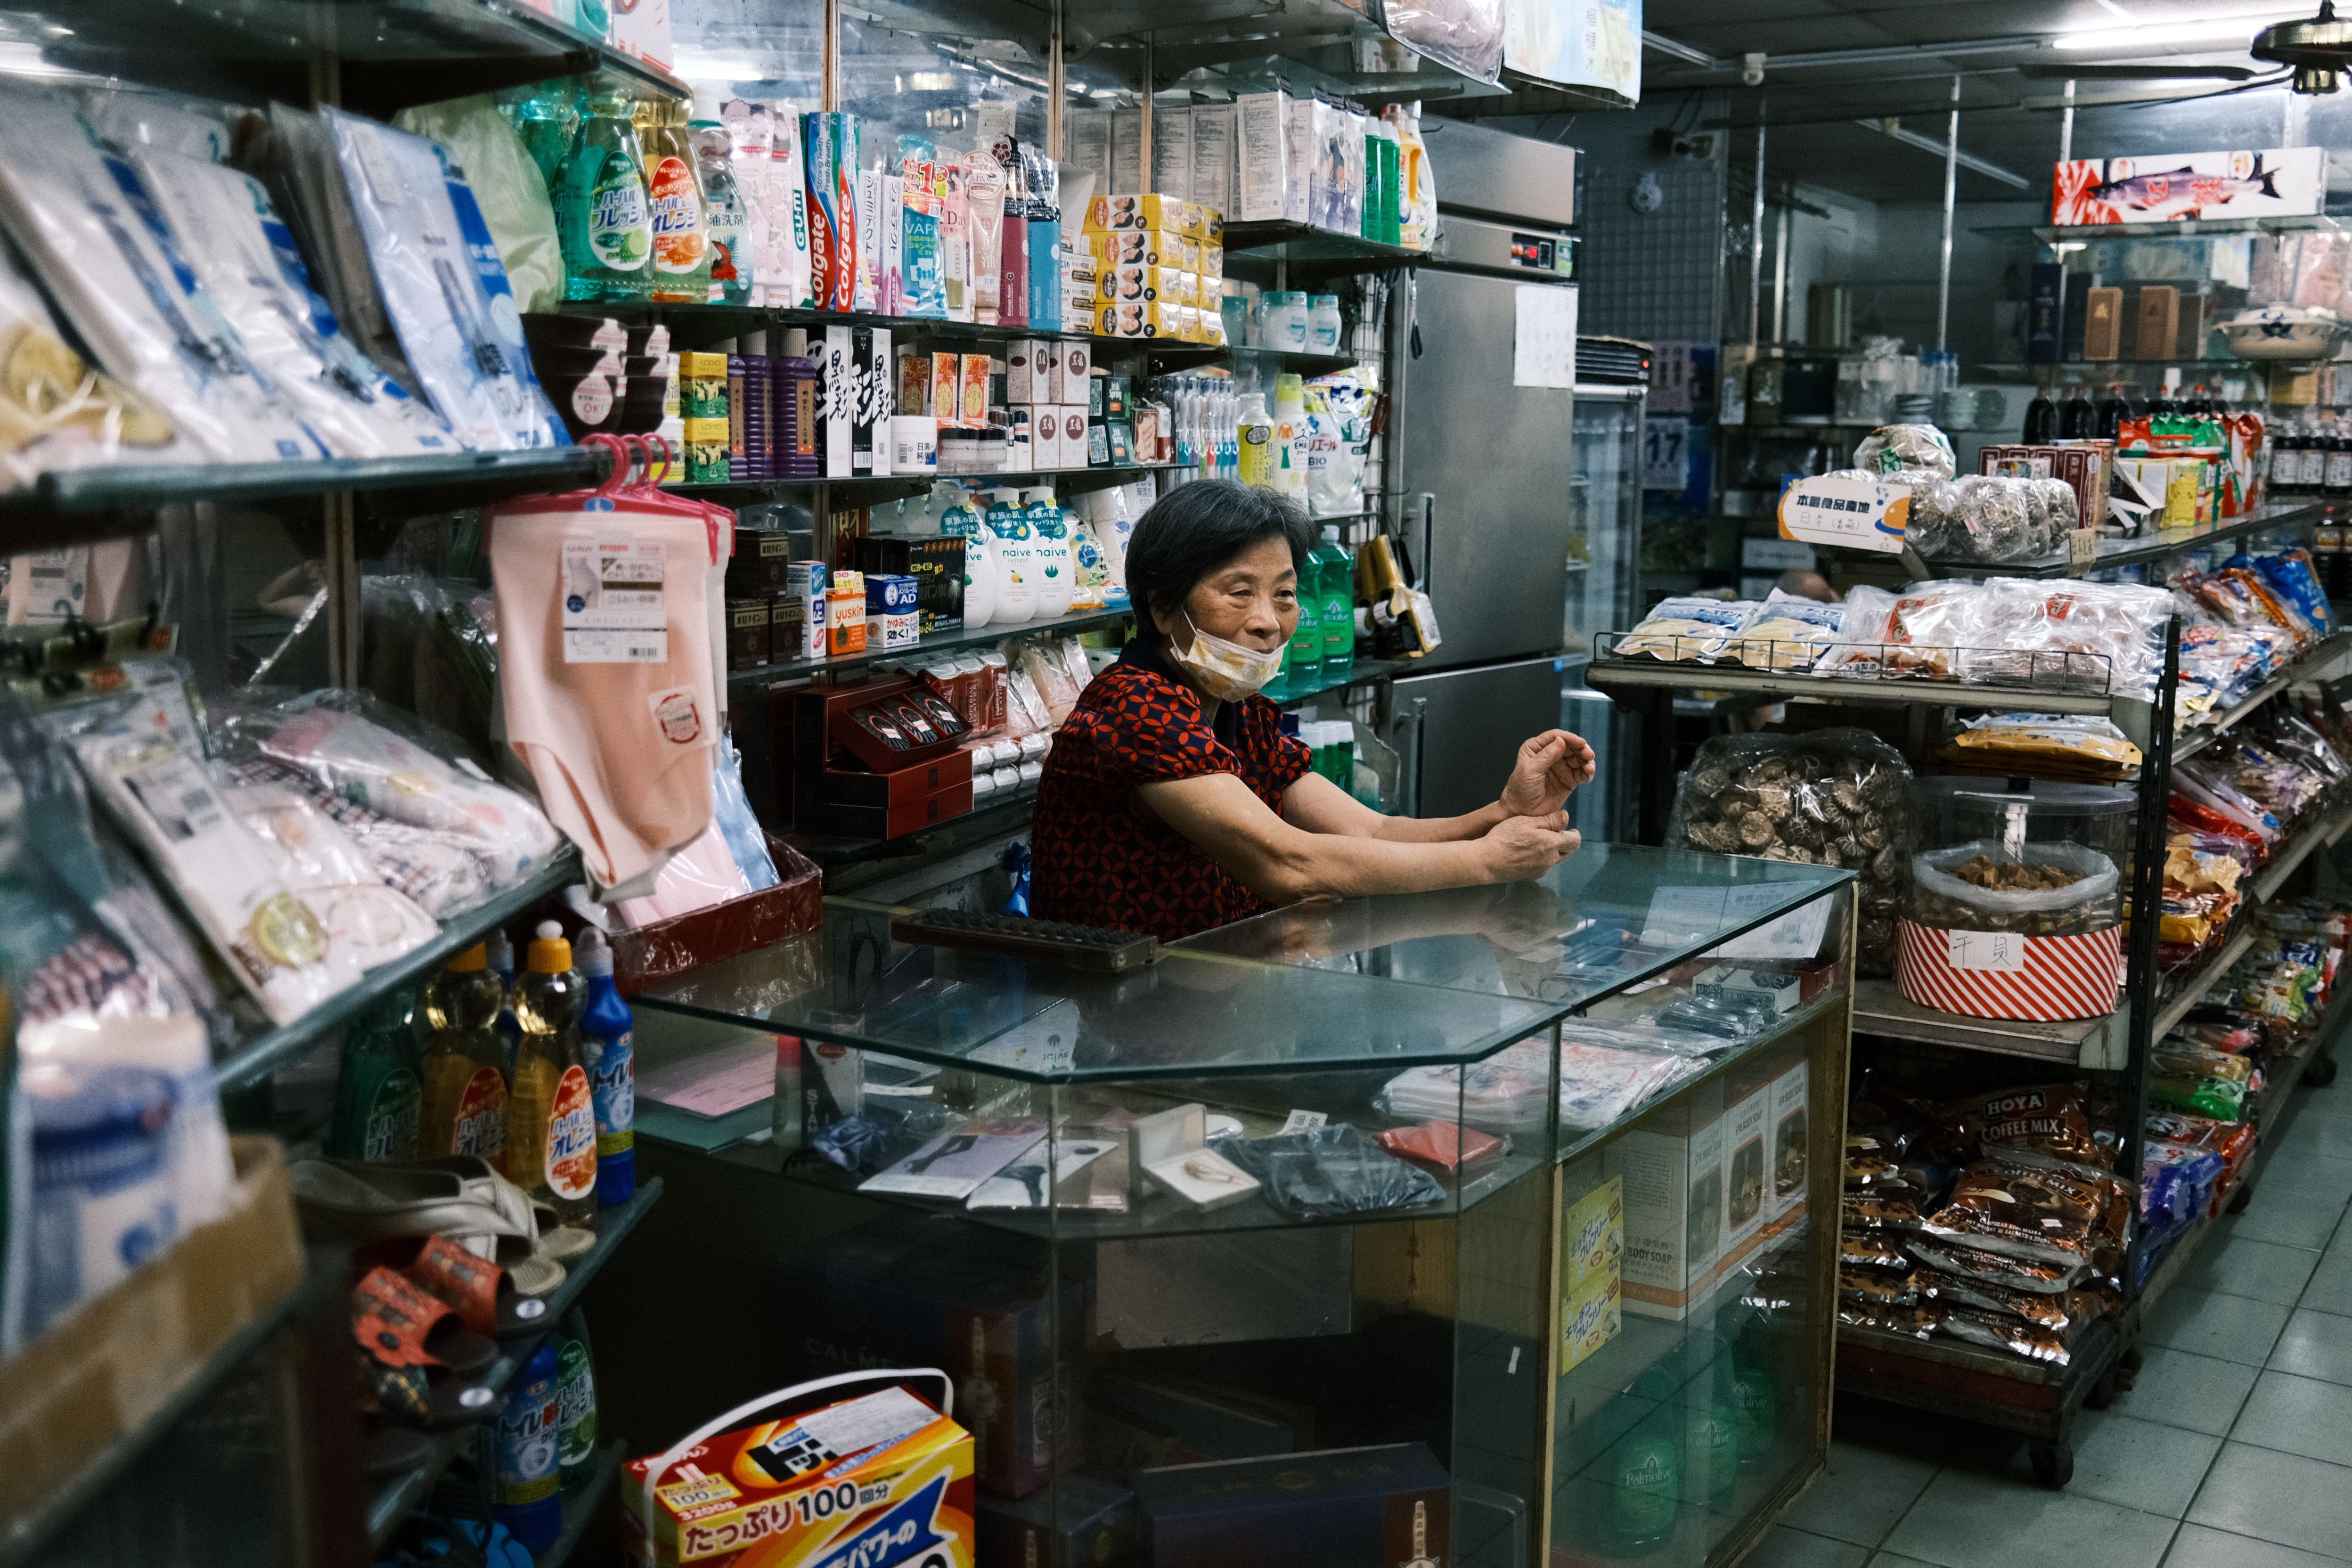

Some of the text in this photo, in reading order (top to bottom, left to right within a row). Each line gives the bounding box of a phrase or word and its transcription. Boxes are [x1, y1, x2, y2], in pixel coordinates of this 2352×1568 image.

[865, 175, 875, 254] シュミテクト
[948, 211, 967, 230] Day
[837, 194, 853, 307] Colgate
[813, 214, 828, 307] Colgate
[1109, 389, 1122, 401] Spring
[1111, 381, 1120, 390] Irish
[1646, 434, 1682, 463] 17
[1309, 457, 1327, 466] BIO
[989, 510, 1024, 520] 家族の肌、
[1027, 509, 1060, 519] 家族の肌、
[1003, 548, 1031, 557] naive
[1036, 546, 1067, 558] naive
[900, 594, 917, 605] AD
[836, 605, 864, 623] yuskin
[886, 617, 909, 628] かゆみに
[1986, 1094, 2044, 1116] HOYA
[1981, 1119, 2060, 1144] COFFEE MIX
[551, 1128, 594, 1161] オレンジ
[2046, 1179, 2076, 1195] MIX
[1571, 1218, 1594, 1258] キッチン
[1628, 1246, 1649, 1260] BODY
[1651, 1251, 1672, 1265] SOAP
[1565, 1298, 1591, 1341] キッチン
[1626, 1467, 1672, 1486] Palmolive
[685, 1501, 791, 1555] たっぷり
